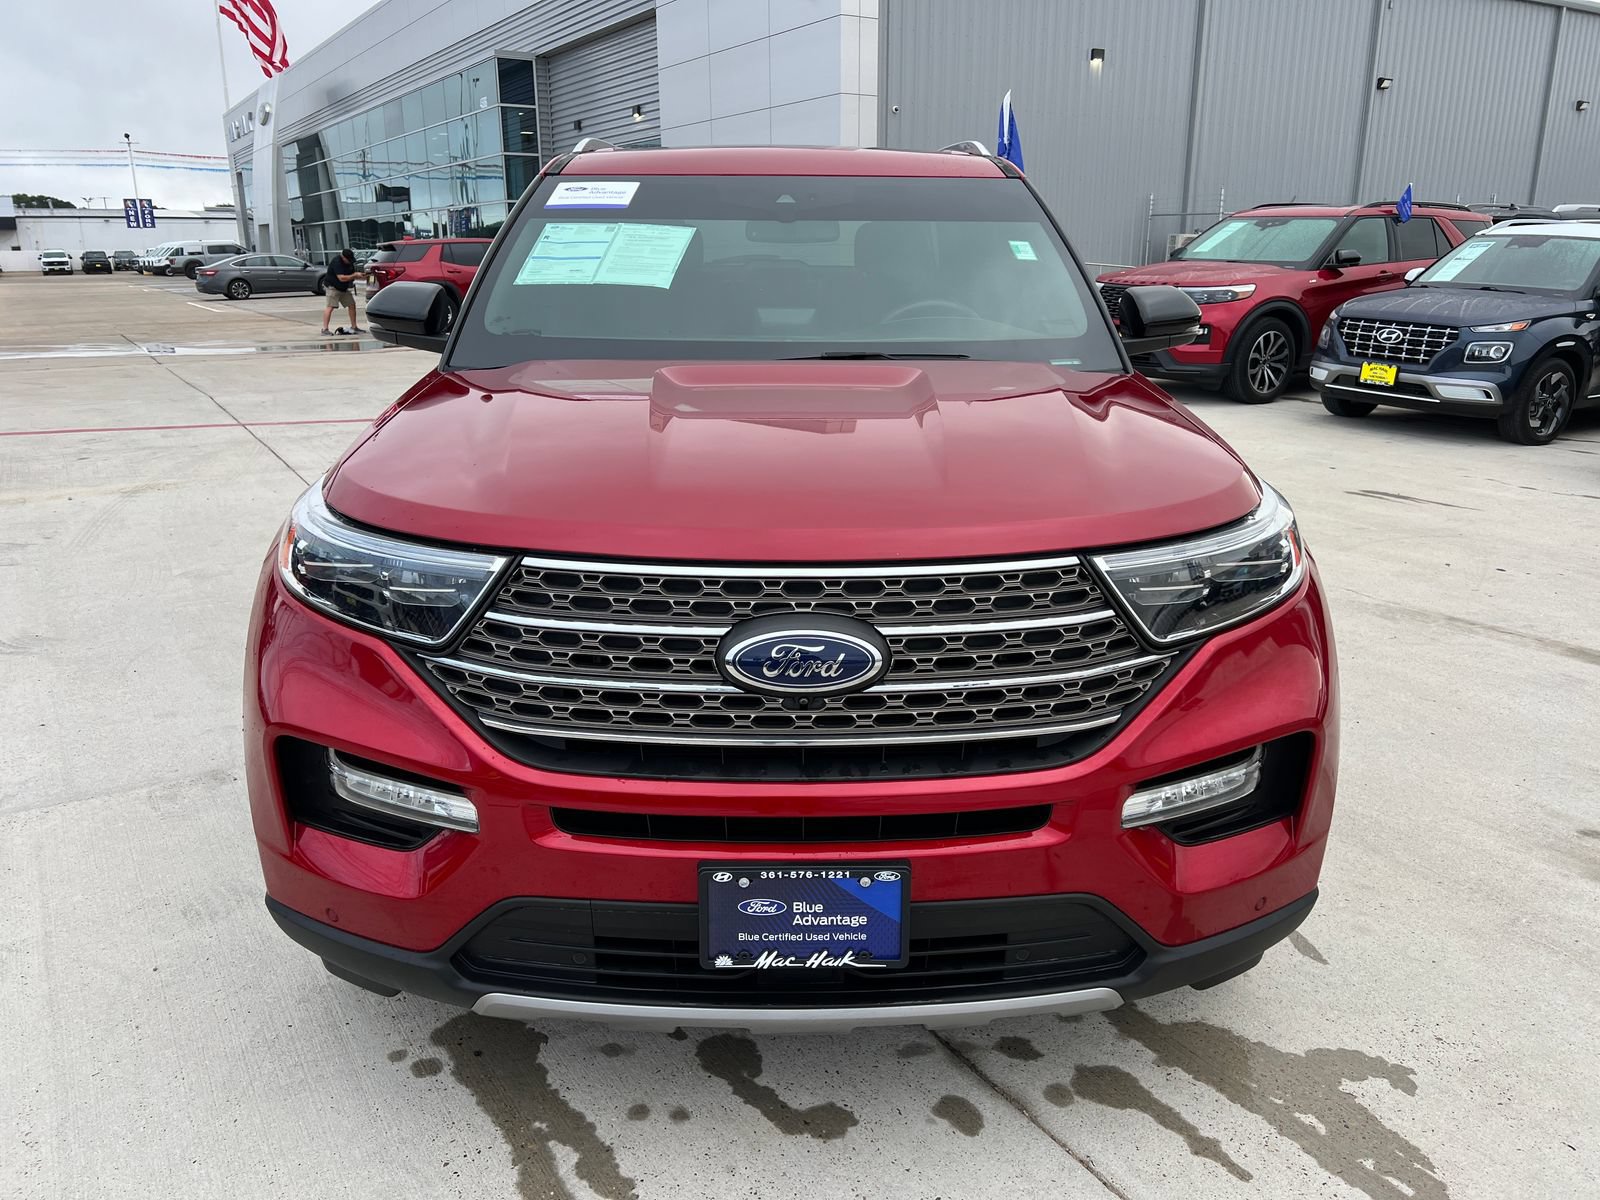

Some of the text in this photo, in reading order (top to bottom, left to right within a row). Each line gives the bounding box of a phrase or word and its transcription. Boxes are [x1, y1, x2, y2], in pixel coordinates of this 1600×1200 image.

[763, 644, 846, 678] Ford
[760, 871, 850, 879] 361-576-1221
[747, 901, 777, 913] Ford
[792, 902, 824, 913] Blue
[792, 914, 868, 927] Advantage
[738, 932, 867, 941] Blue Certified Used Vehicle
[753, 950, 857, 969] Mac Haik
